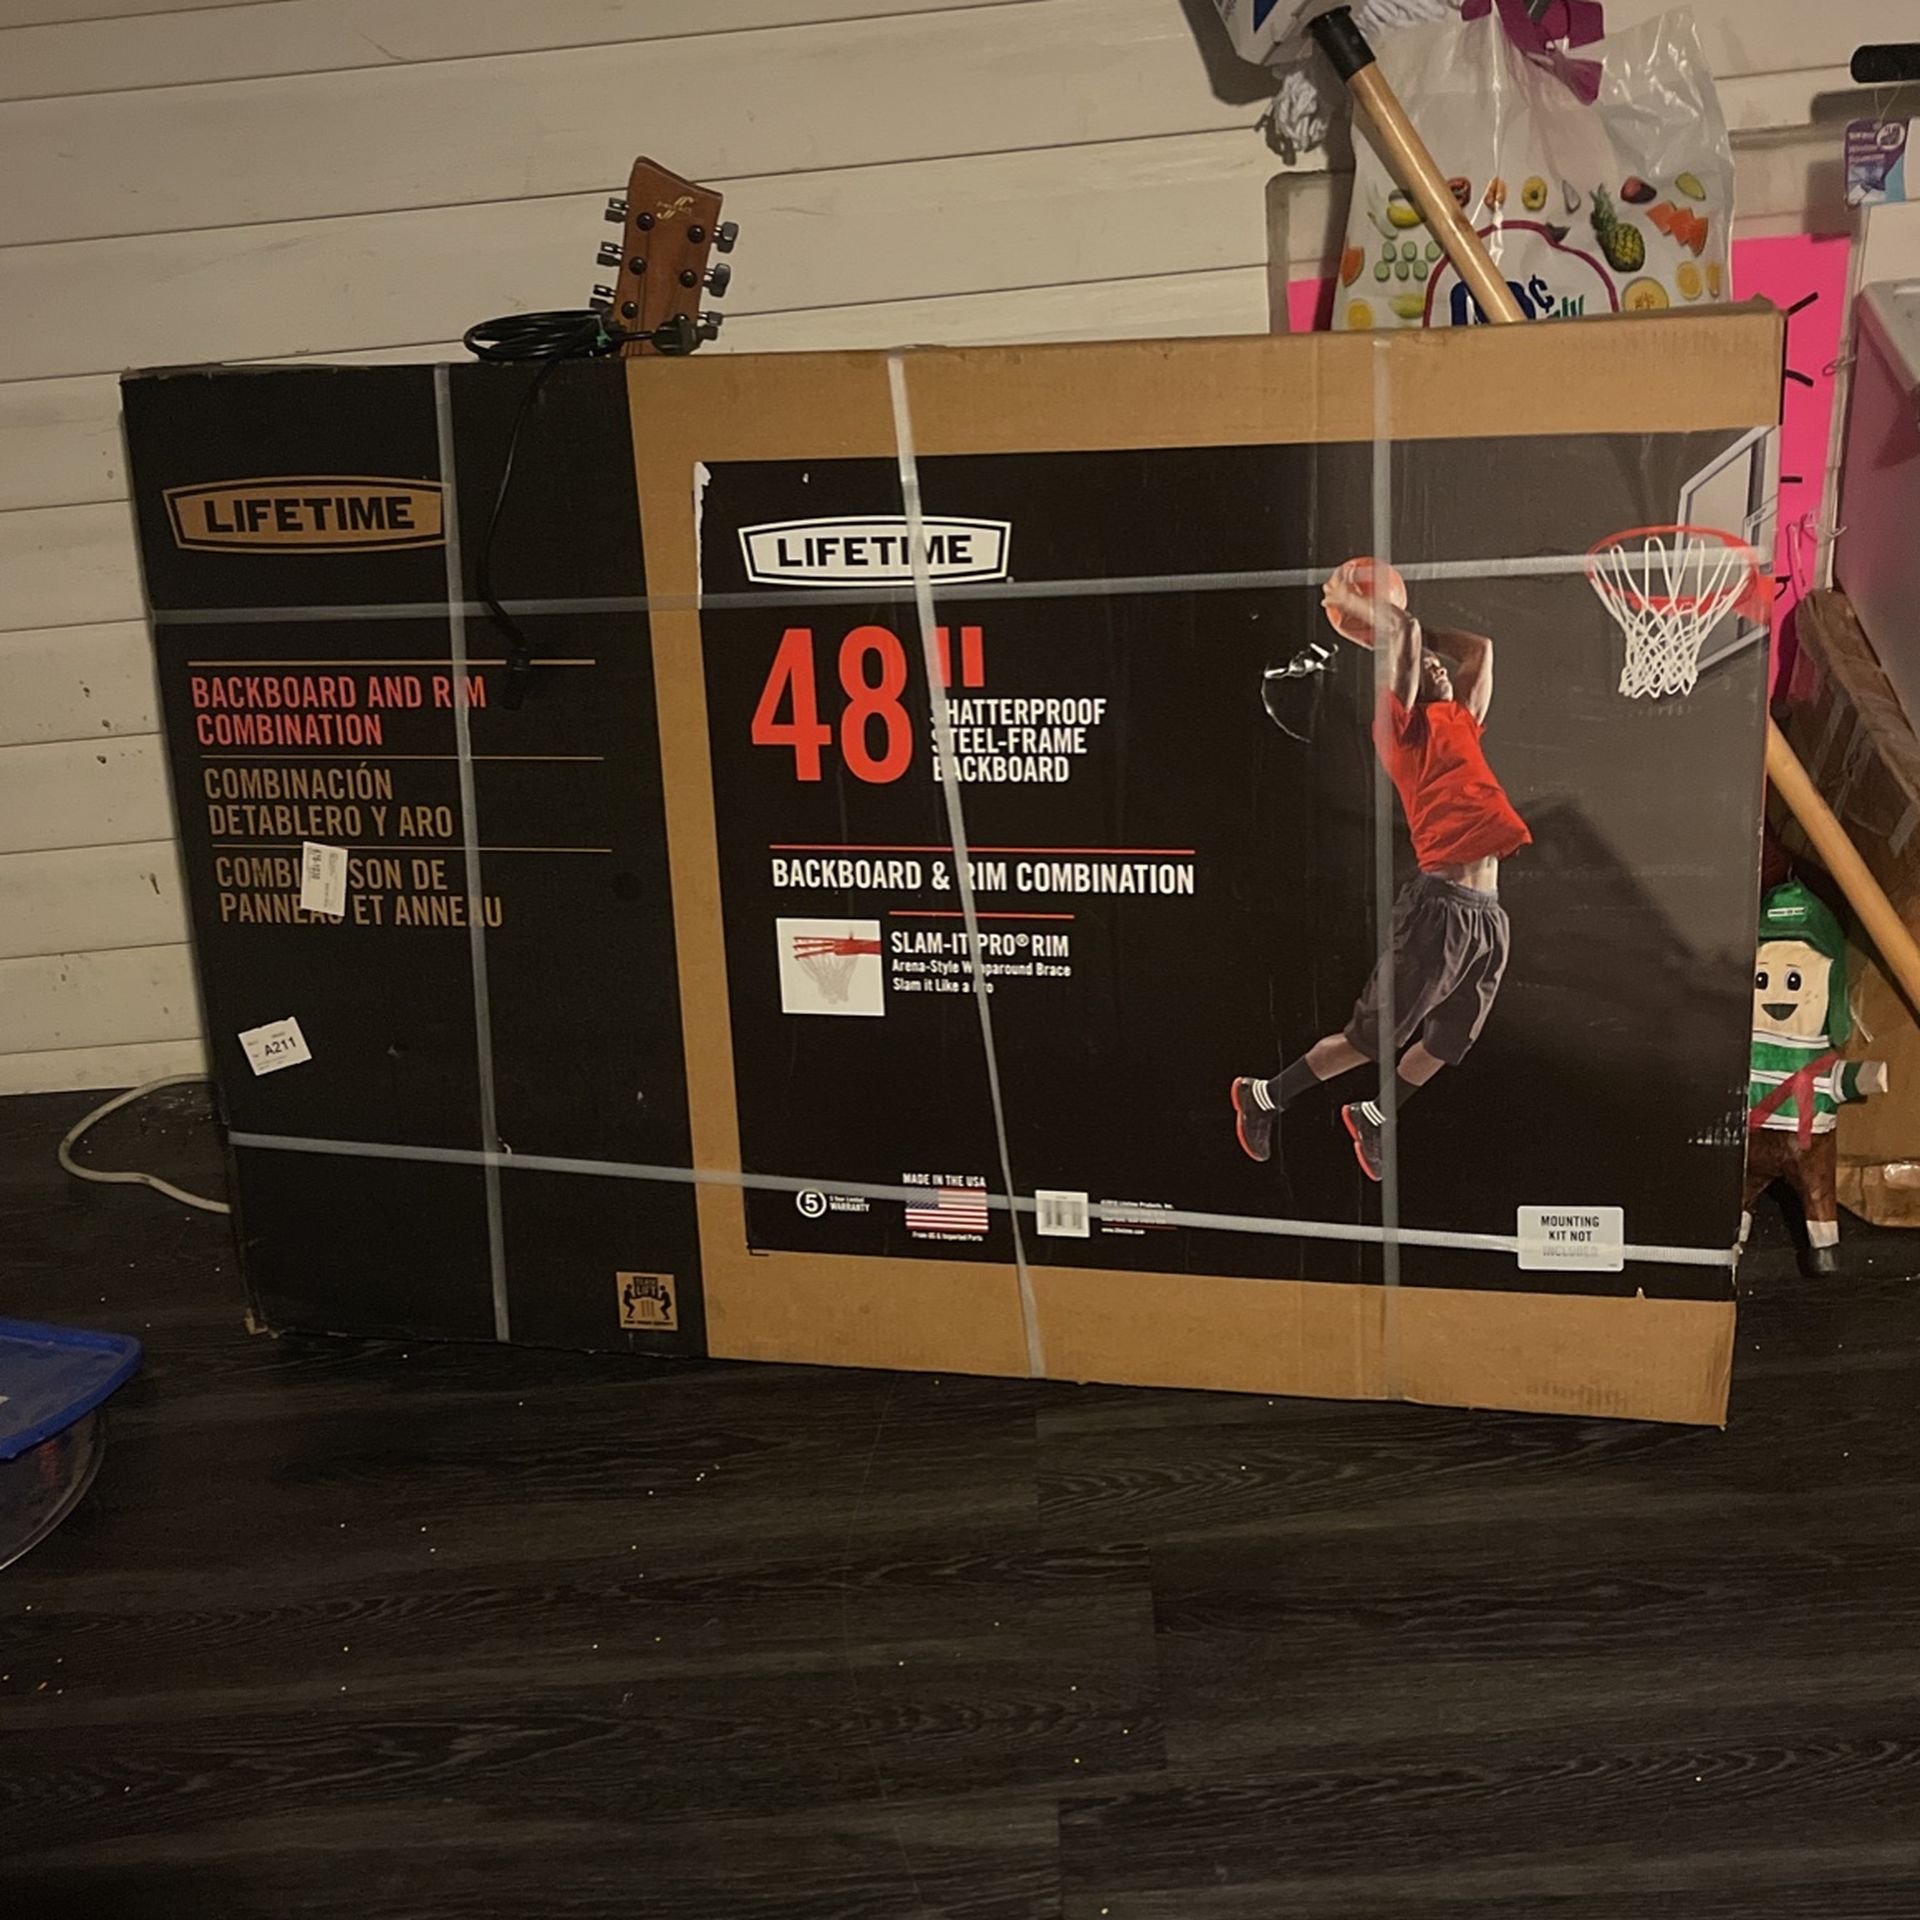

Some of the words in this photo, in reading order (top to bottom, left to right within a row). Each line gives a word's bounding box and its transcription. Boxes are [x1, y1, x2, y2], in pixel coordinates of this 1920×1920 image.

[203, 496, 415, 533] LIFETIME
[777, 534, 973, 567] LIFETIME
[191, 676, 357, 708] BACKBOARD
[367, 676, 423, 708] AND
[432, 676, 486, 708] RM
[930, 699, 1107, 725] HATTERPROOF
[196, 714, 383, 746] COMBINATION
[204, 762, 392, 800] COMBINACIÓN
[209, 805, 362, 836] DETABLERO
[374, 806, 387, 837] Y
[400, 806, 454, 838] ARO
[215, 857, 402, 890] COMBISON
[412, 859, 448, 890] DE
[772, 859, 922, 891] BACKBOARD
[931, 861, 951, 890] &
[1016, 862, 1195, 894] COMBINATION
[353, 894, 384, 925] ET
[395, 896, 503, 928] ANNEU
[890, 931, 969, 955] SLAM-IT
[1032, 935, 1070, 957] RIM
[892, 958, 959, 975] Arena-Style
[1036, 963, 1071, 977] Brace
[893, 977, 922, 991] Slam
[924, 978, 933, 992] it
[936, 979, 959, 992] Like
[962, 981, 970, 993] a
[264, 1036, 296, 1056] A211
[902, 1173, 929, 1185] MADE
[932, 1174, 943, 1185] IN
[945, 1175, 963, 1186] THE
[966, 1176, 986, 1187] USA
[804, 1193, 819, 1212] 5
[830, 1202, 870, 1212] WARRANTY
[1541, 1215, 1600, 1227] MOUNTING
[1548, 1230, 1567, 1241] KIT
[1570, 1230, 1592, 1242] NOT
